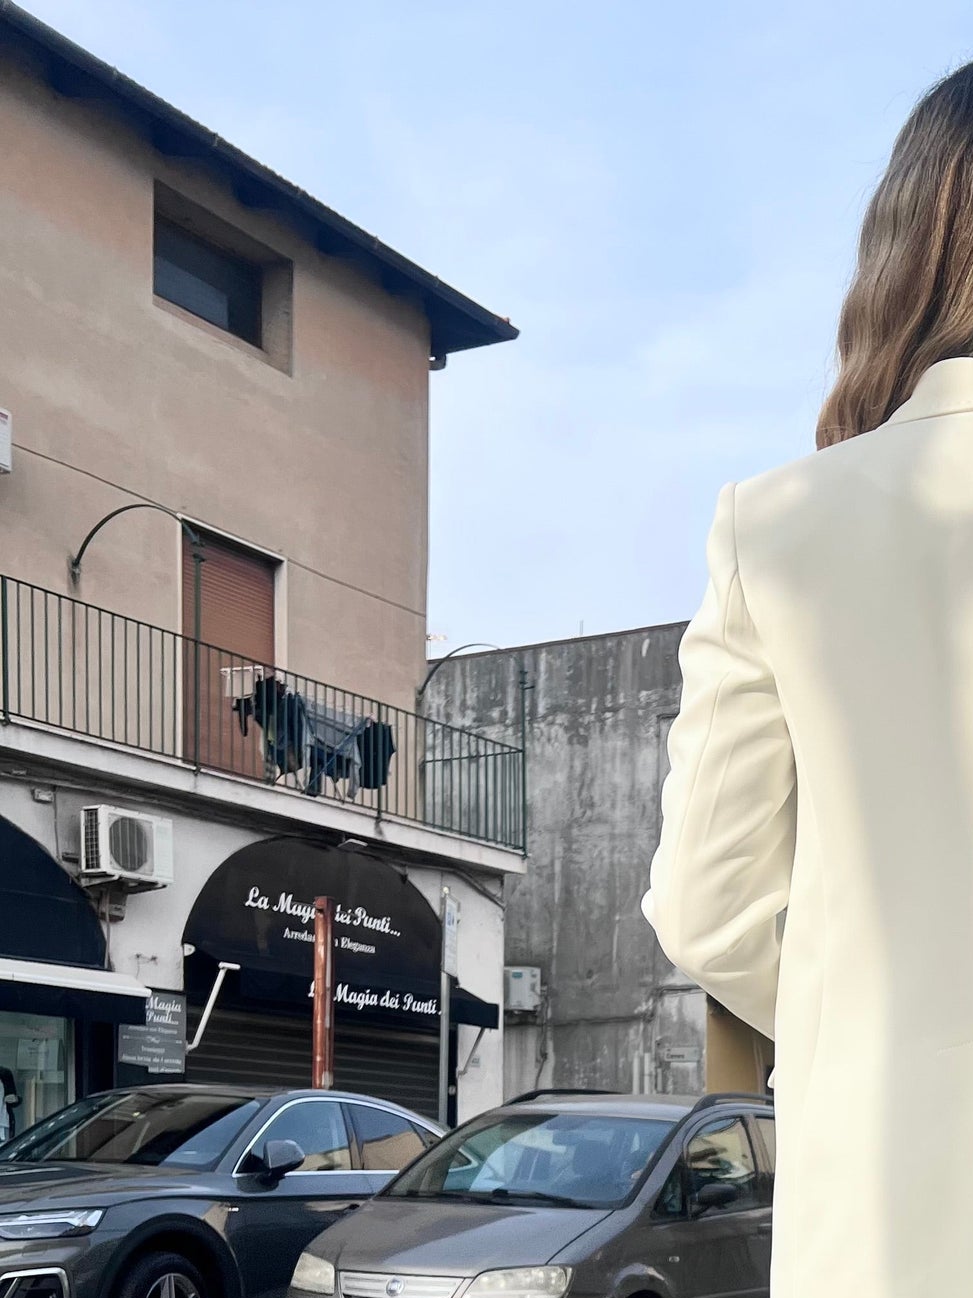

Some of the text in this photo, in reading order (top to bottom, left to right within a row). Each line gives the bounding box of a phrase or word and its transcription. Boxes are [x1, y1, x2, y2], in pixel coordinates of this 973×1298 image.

[245, 886, 270, 910] La
[272, 891, 316, 924] Magi
[145, 996, 181, 1014] Magia
[333, 983, 378, 1010] Magia
[380, 990, 400, 1010] dei
